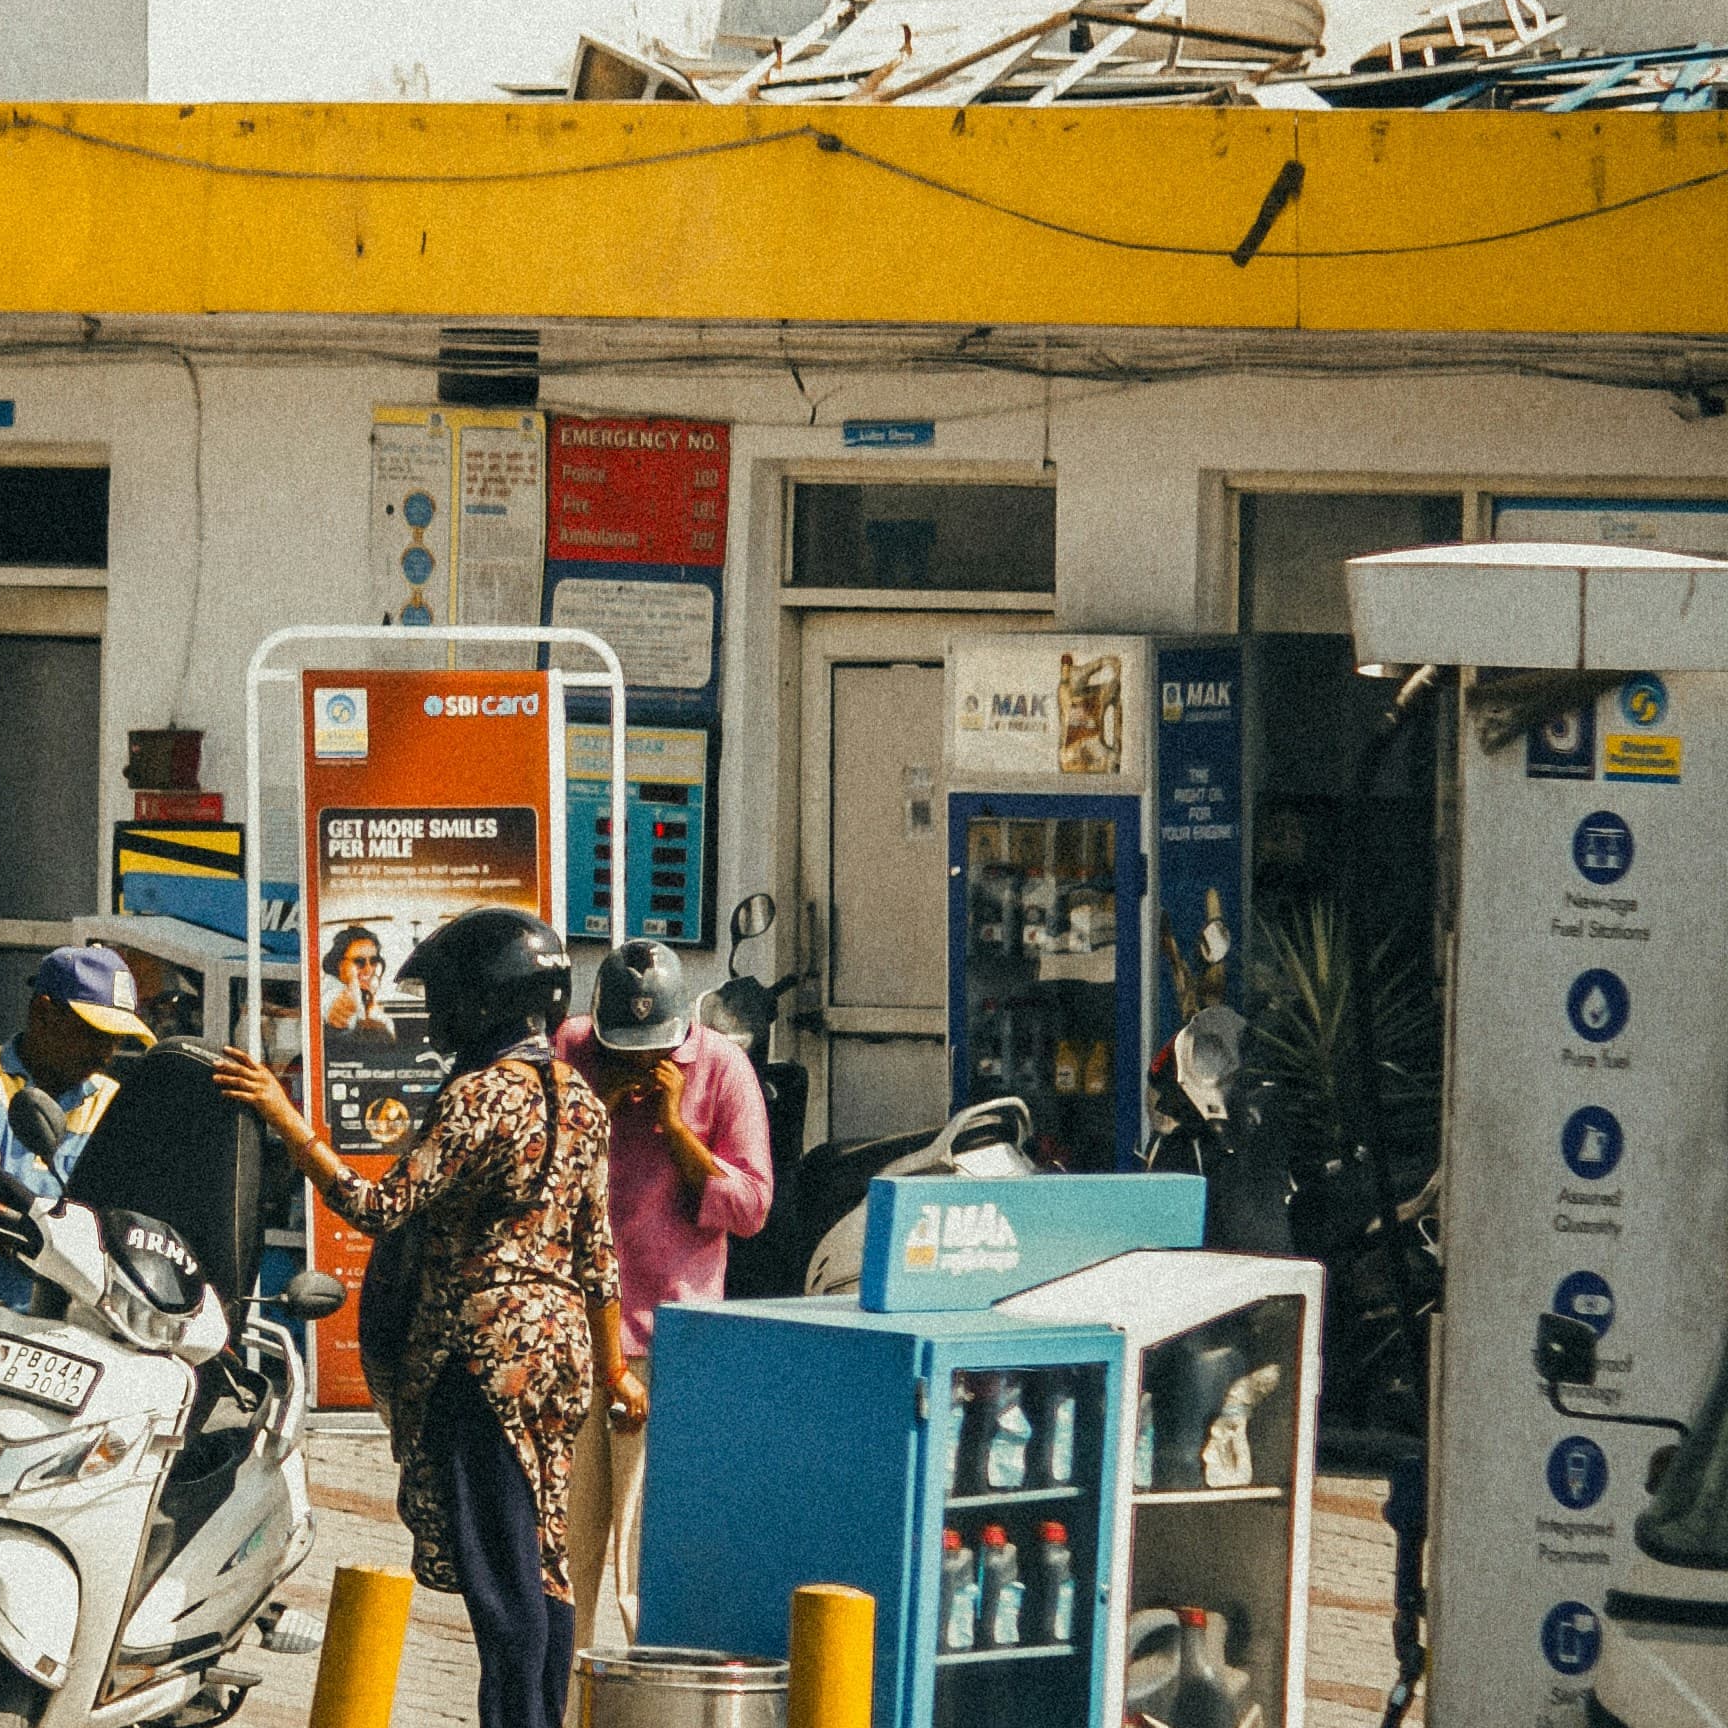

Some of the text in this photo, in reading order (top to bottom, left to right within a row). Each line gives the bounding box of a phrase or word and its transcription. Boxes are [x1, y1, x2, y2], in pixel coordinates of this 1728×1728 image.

[560, 427, 721, 452] EMERGENCY NO.
[445, 692, 540, 717] SBI card
[991, 693, 1050, 718] MAK
[1186, 681, 1232, 708] MAK
[327, 818, 498, 839] GET MORE SMILES
[327, 838, 413, 859] PER MILE
[127, 1227, 198, 1276] ARMY
[24, 1372, 81, 1404] 3002
